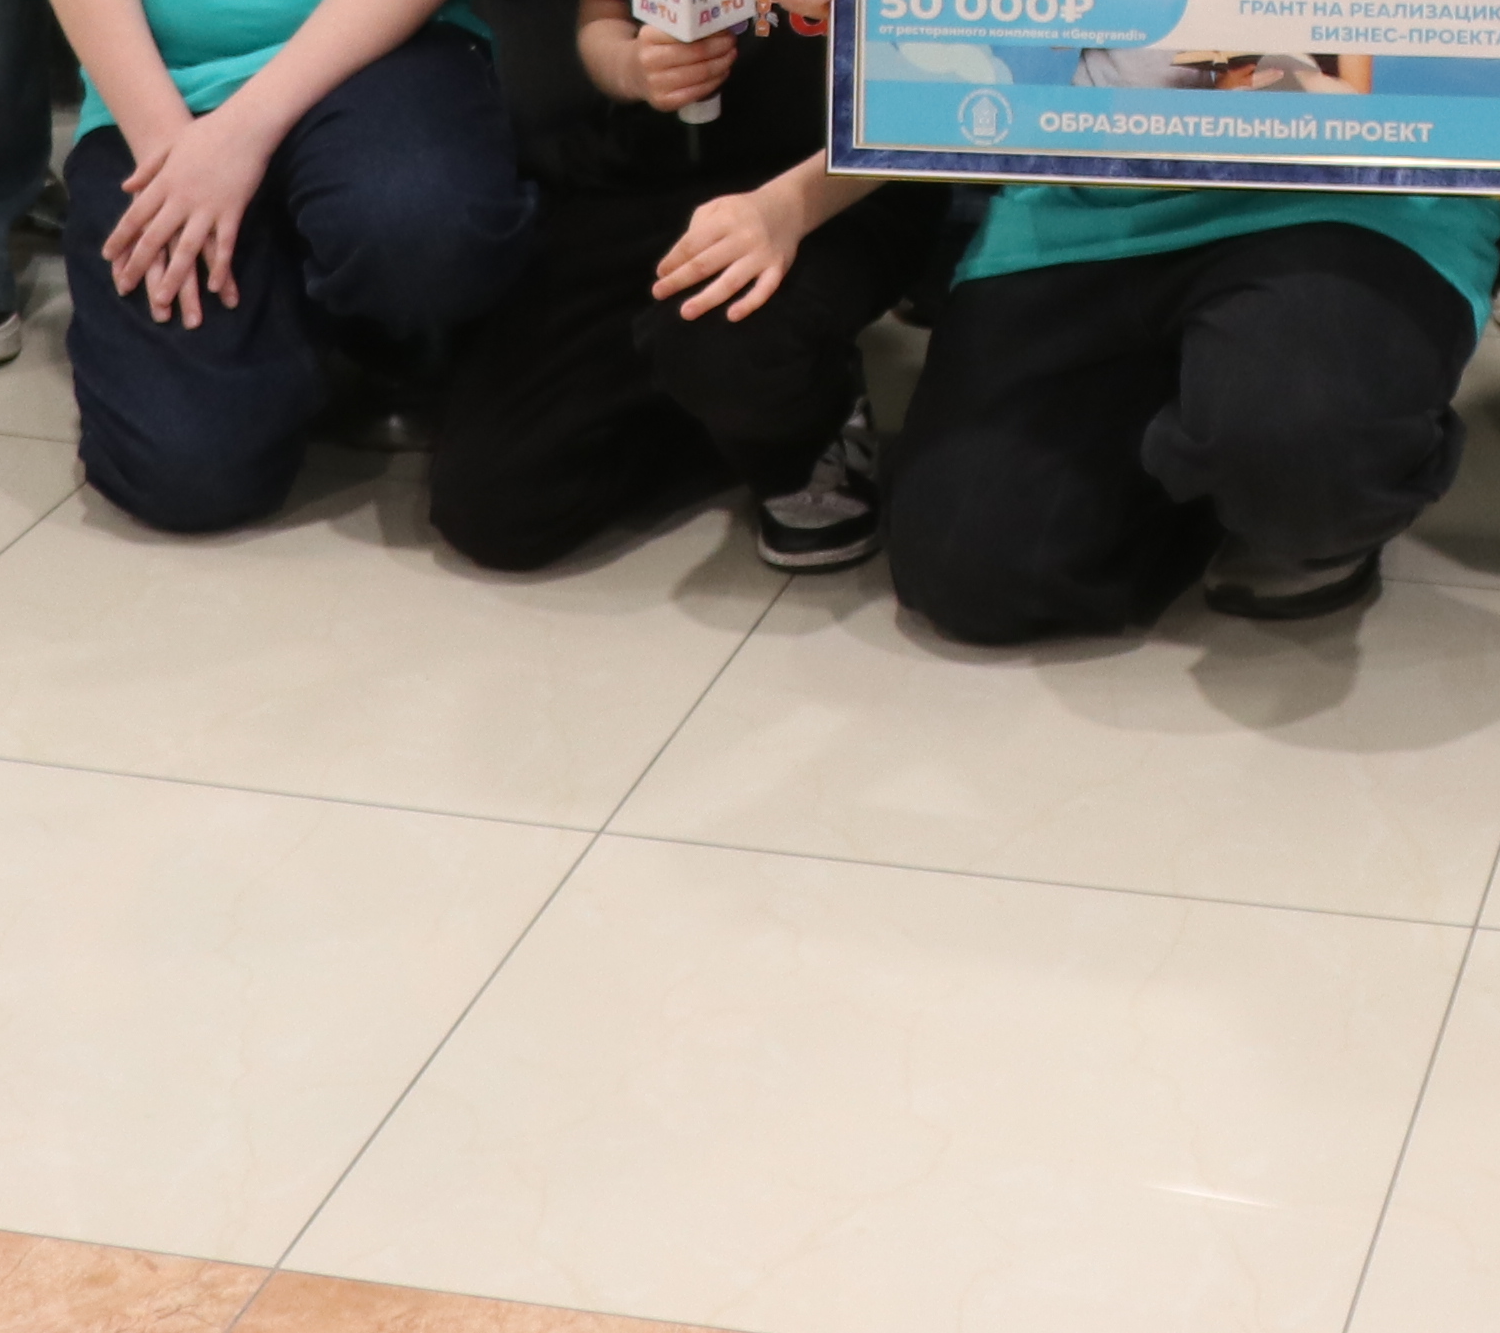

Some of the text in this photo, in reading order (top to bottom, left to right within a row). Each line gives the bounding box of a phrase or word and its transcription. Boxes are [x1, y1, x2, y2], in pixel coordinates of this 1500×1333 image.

[1238, 0, 1308, 17] ГРАНТ
[1312, 1, 1344, 18] НА
[879, 24, 894, 35] от
[896, 25, 987, 39] ресторанного
[988, 28, 1059, 40] комплекса
[1039, 111, 1435, 144] ОБРАЗОВАТЕЛЬНЫЙ ПРОЕКТ
